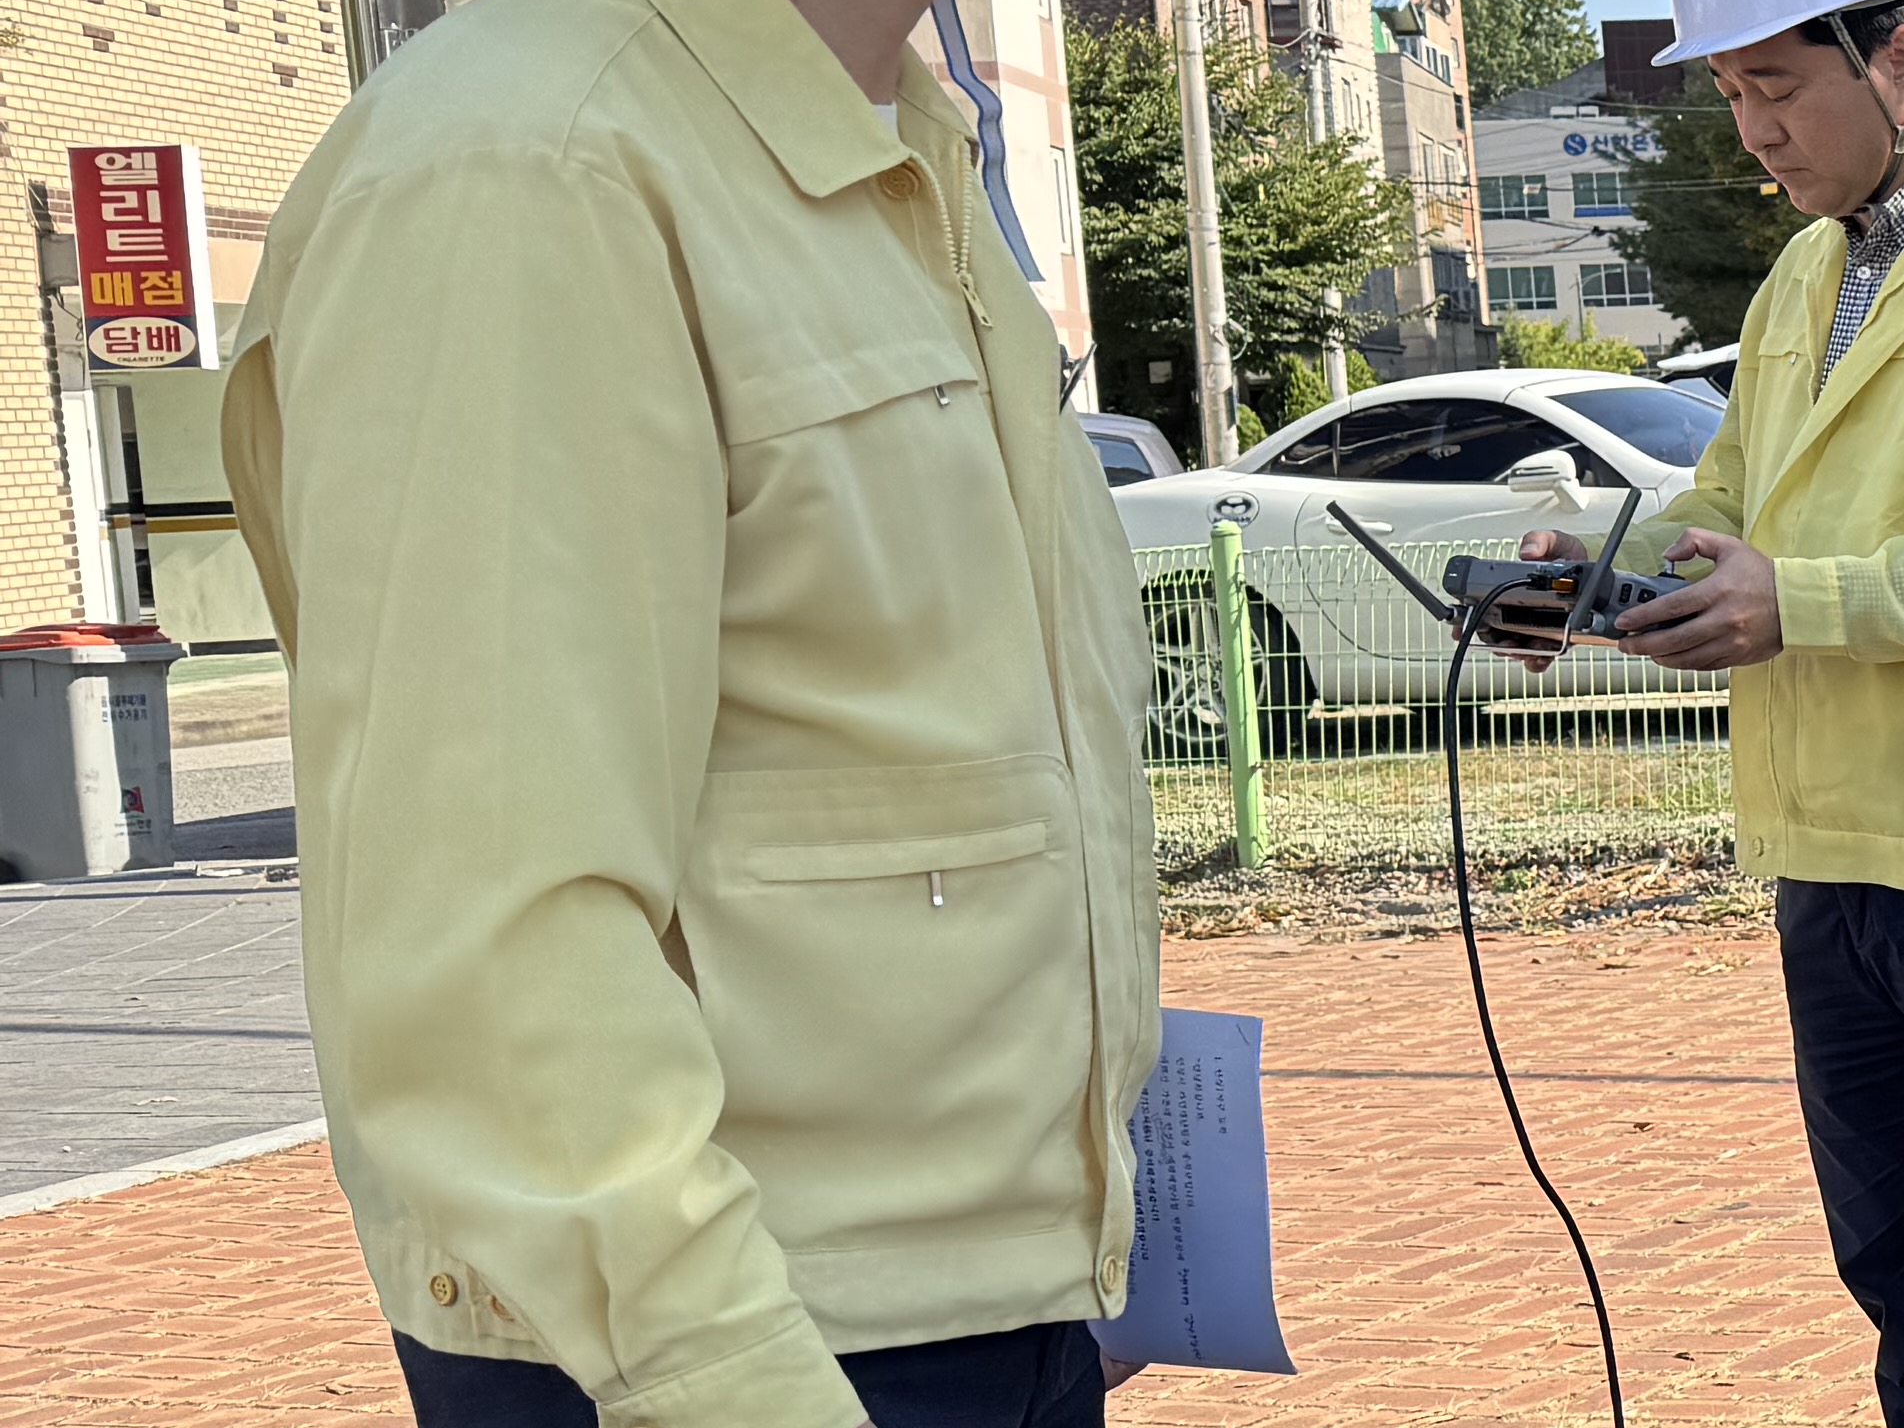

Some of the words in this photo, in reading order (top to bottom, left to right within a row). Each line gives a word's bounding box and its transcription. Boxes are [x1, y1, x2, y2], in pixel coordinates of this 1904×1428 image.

[94, 151, 169, 263] 엘리트
[89, 270, 186, 307] 매점
[102, 325, 183, 354] 담배
